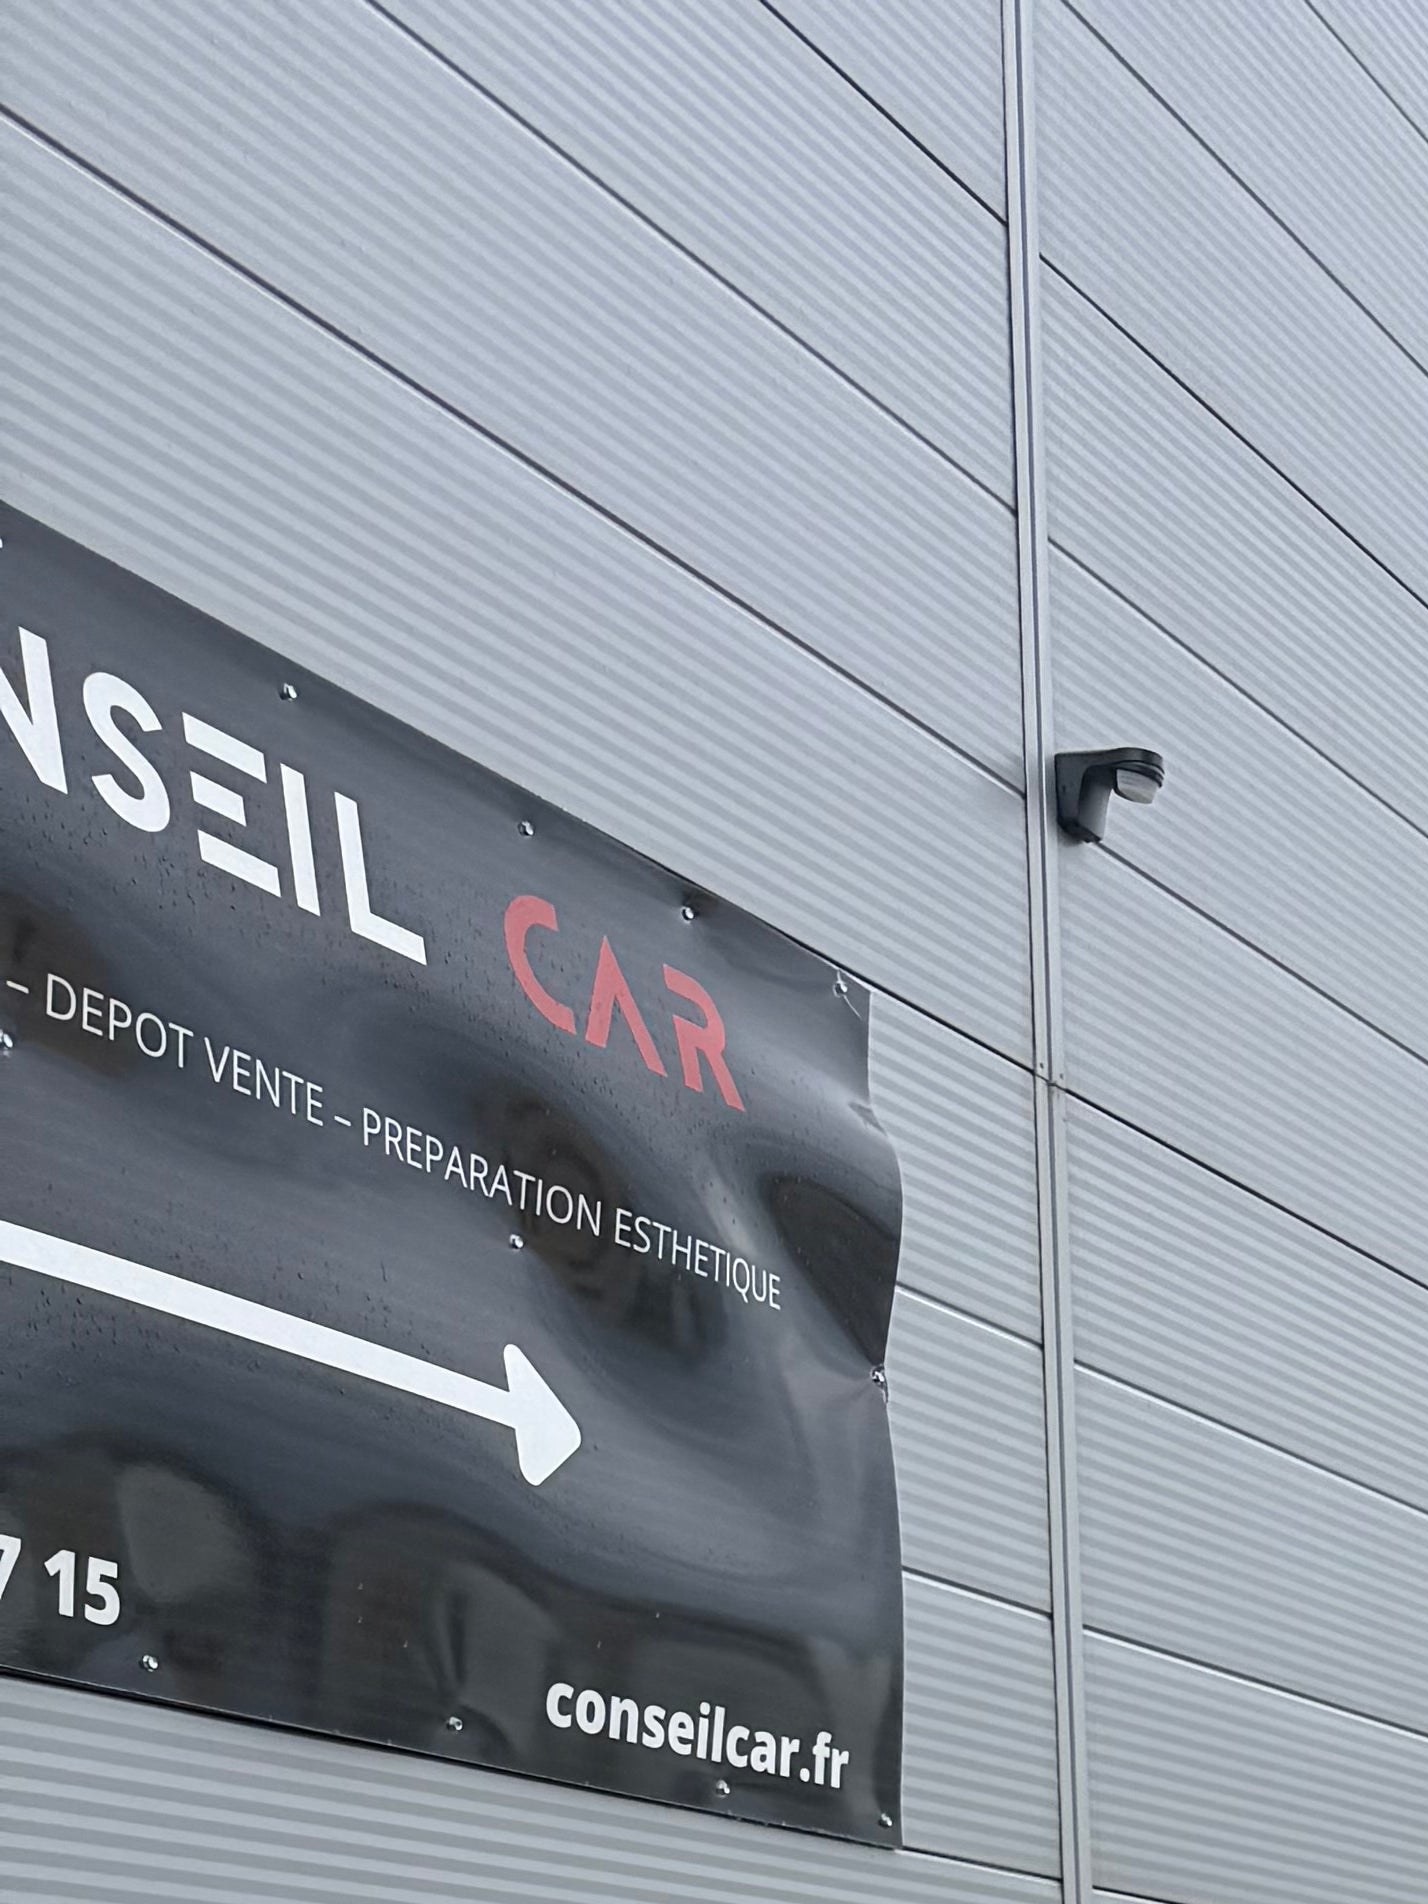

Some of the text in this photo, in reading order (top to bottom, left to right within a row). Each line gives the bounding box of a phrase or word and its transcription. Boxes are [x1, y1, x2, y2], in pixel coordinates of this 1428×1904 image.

[504, 895, 746, 1112] CAR
[46, 973, 194, 1069] DEPOT
[204, 1037, 324, 1127] VENTE
[363, 1107, 602, 1237] PREPARATION
[615, 1207, 782, 1311] ESTHETIQUE
[44, 1549, 120, 1626] 15
[546, 1682, 850, 1789] conseilcar.fr
